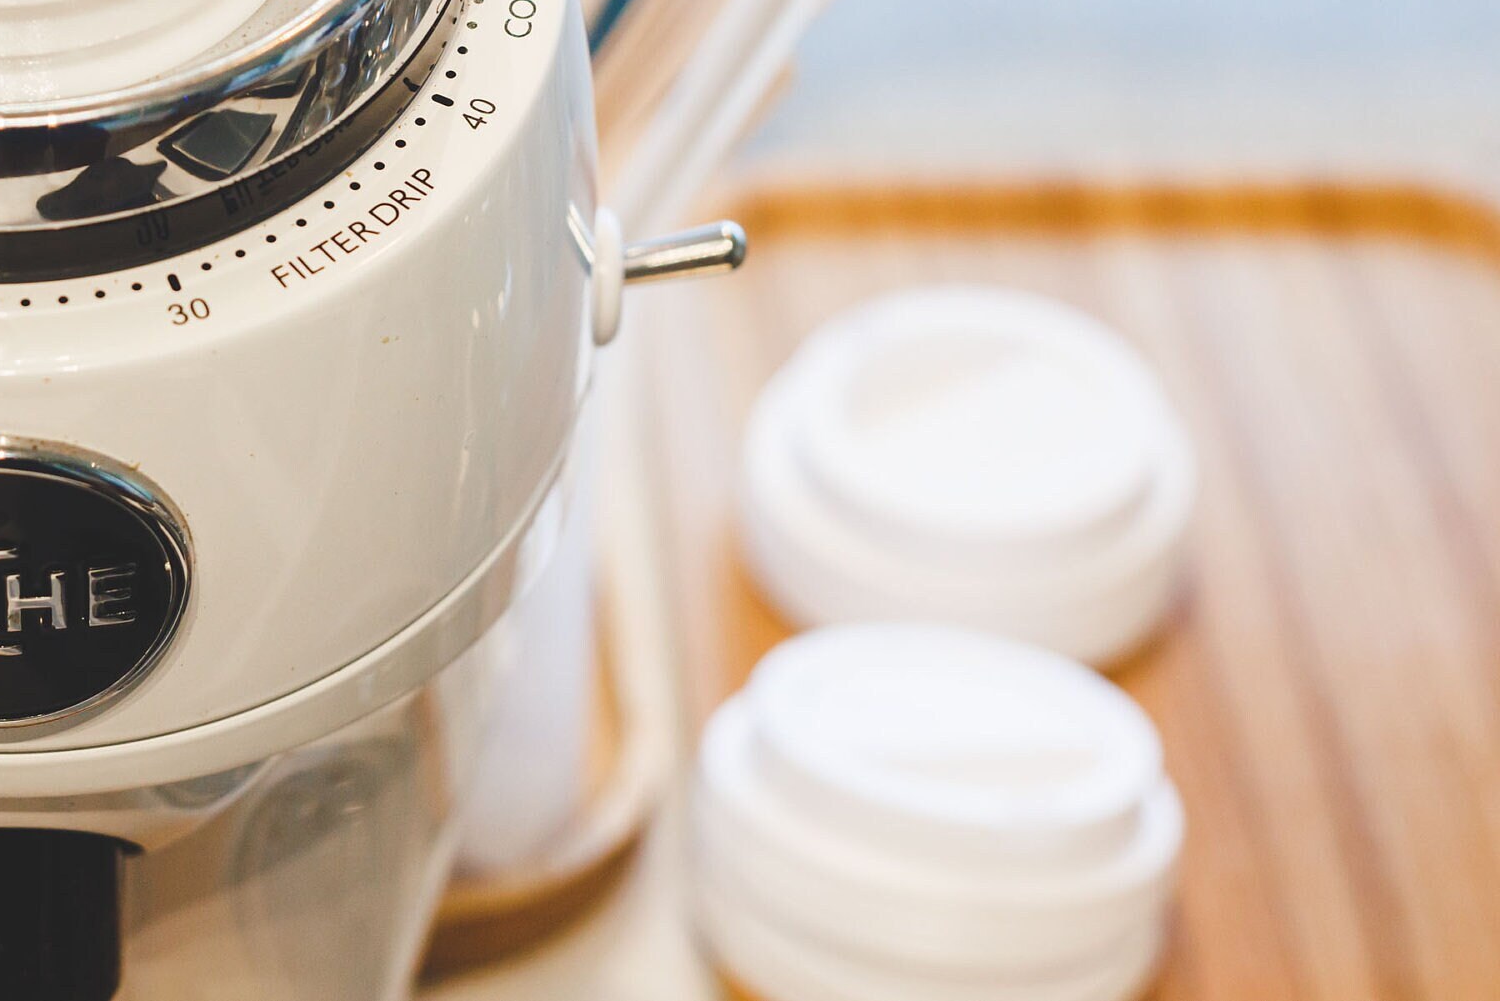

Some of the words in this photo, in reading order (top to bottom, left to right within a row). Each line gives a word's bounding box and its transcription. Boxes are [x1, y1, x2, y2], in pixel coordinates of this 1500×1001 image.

[460, 98, 498, 132] 40
[269, 220, 381, 289] FILTER
[367, 167, 435, 228] DRIP
[166, 297, 212, 327] 30
